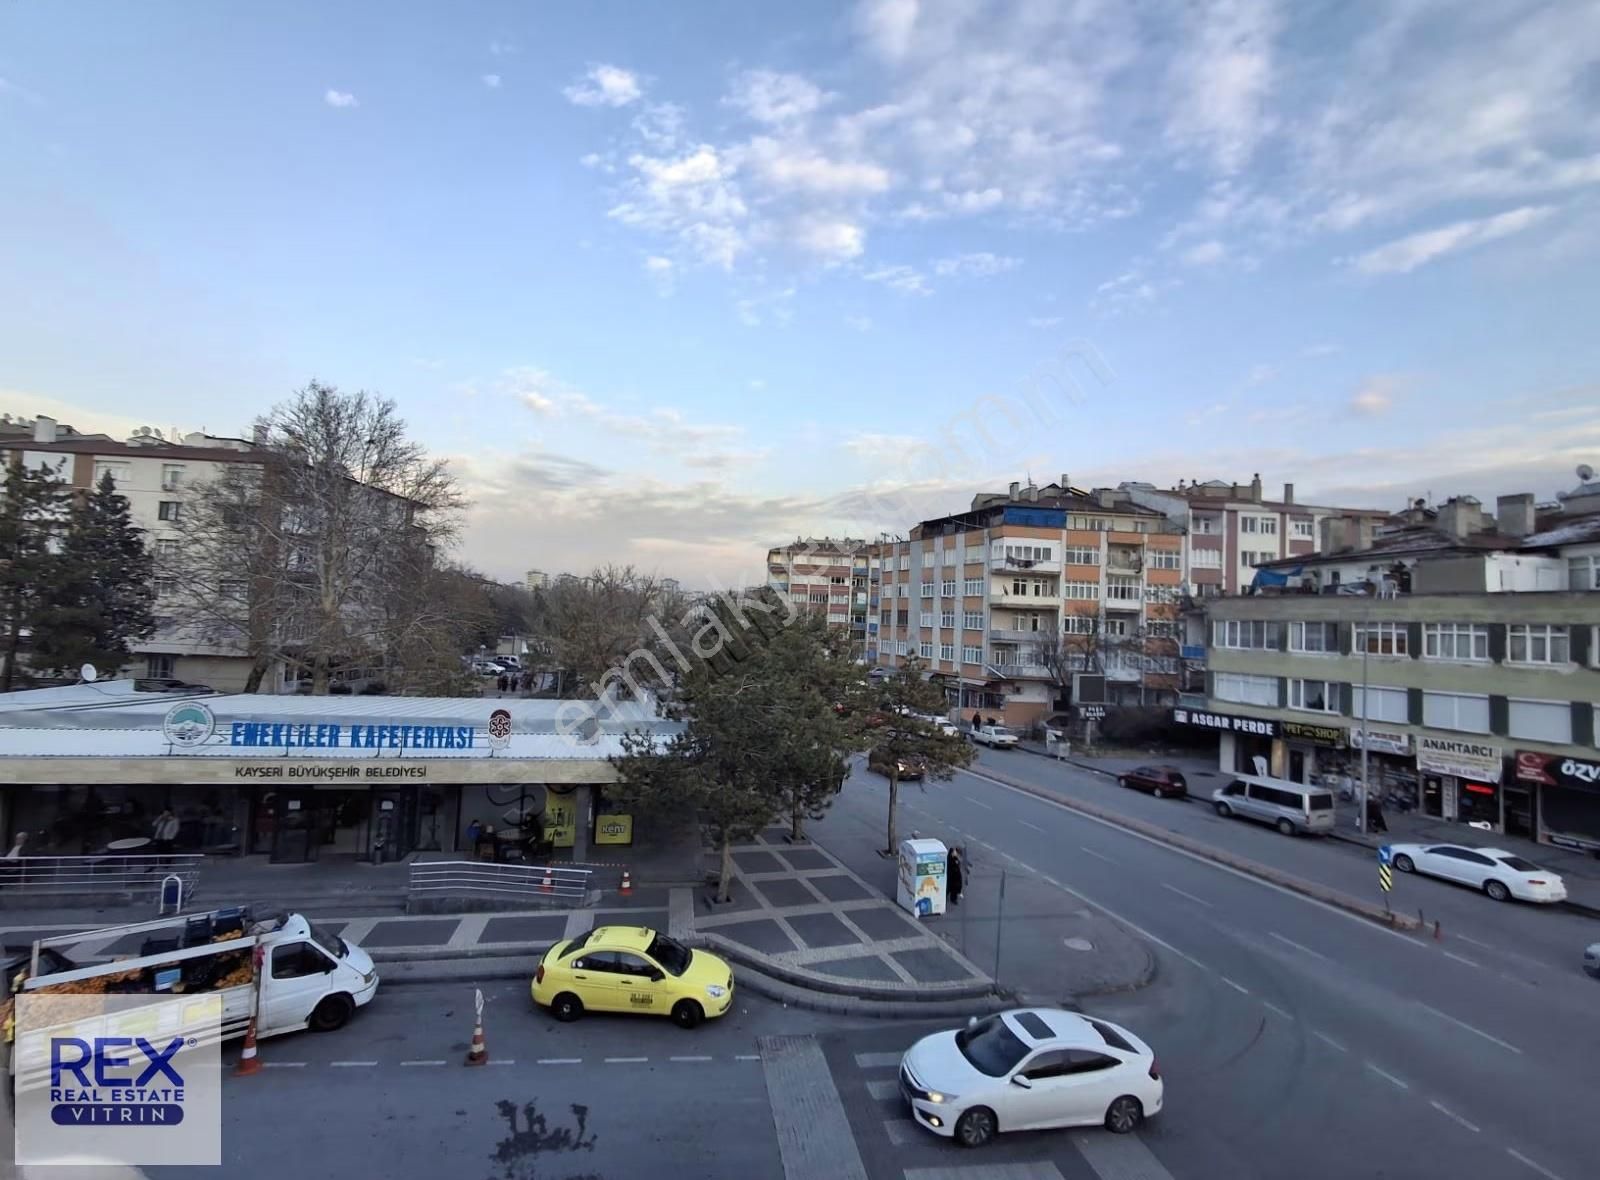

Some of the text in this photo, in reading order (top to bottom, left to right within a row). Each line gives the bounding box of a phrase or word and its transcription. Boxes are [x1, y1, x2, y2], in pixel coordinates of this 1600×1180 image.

[1233, 718, 1274, 736] PERDE
[1315, 727, 1339, 739] SHOP
[351, 725, 474, 749] KAFETERYASI
[1423, 739, 1493, 757] ANAHTARCI
[235, 765, 427, 780] KAYSERİ BÜYÜKŞEHİR BELEDİYESİ
[1561, 758, 1600, 783] ÖZV
